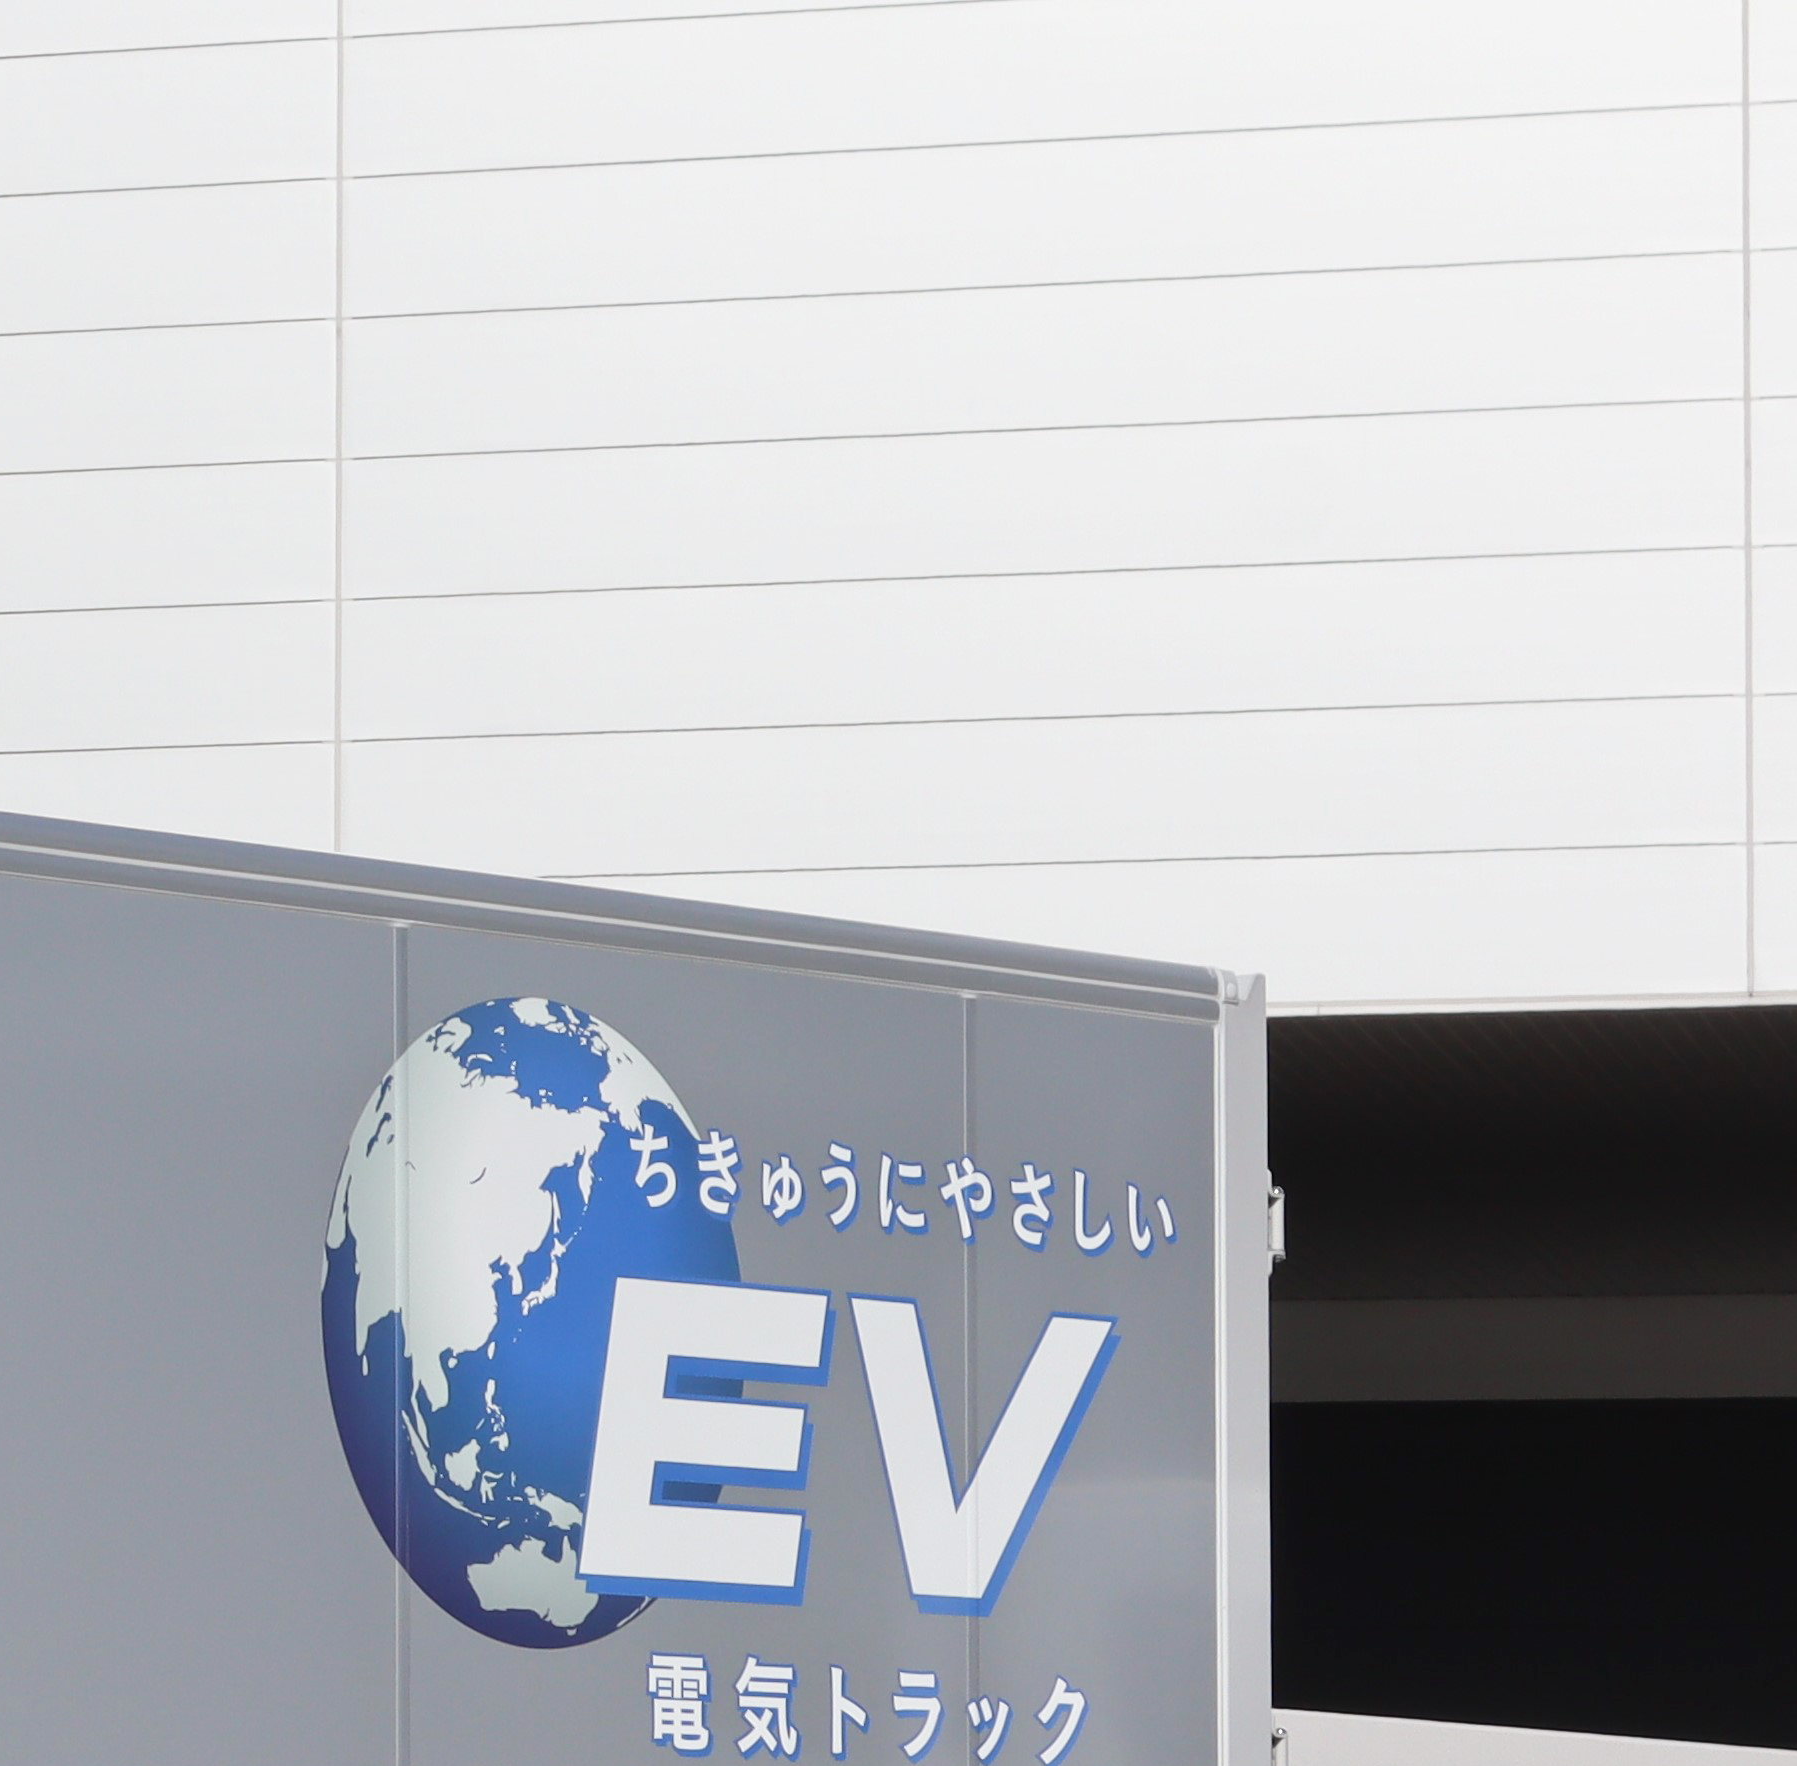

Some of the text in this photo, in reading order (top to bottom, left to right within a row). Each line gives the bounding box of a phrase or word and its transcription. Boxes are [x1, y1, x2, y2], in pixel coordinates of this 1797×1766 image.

[627, 1123, 1176, 1255] ちきゅうにやさしい
[576, 1275, 1120, 1617] EV
